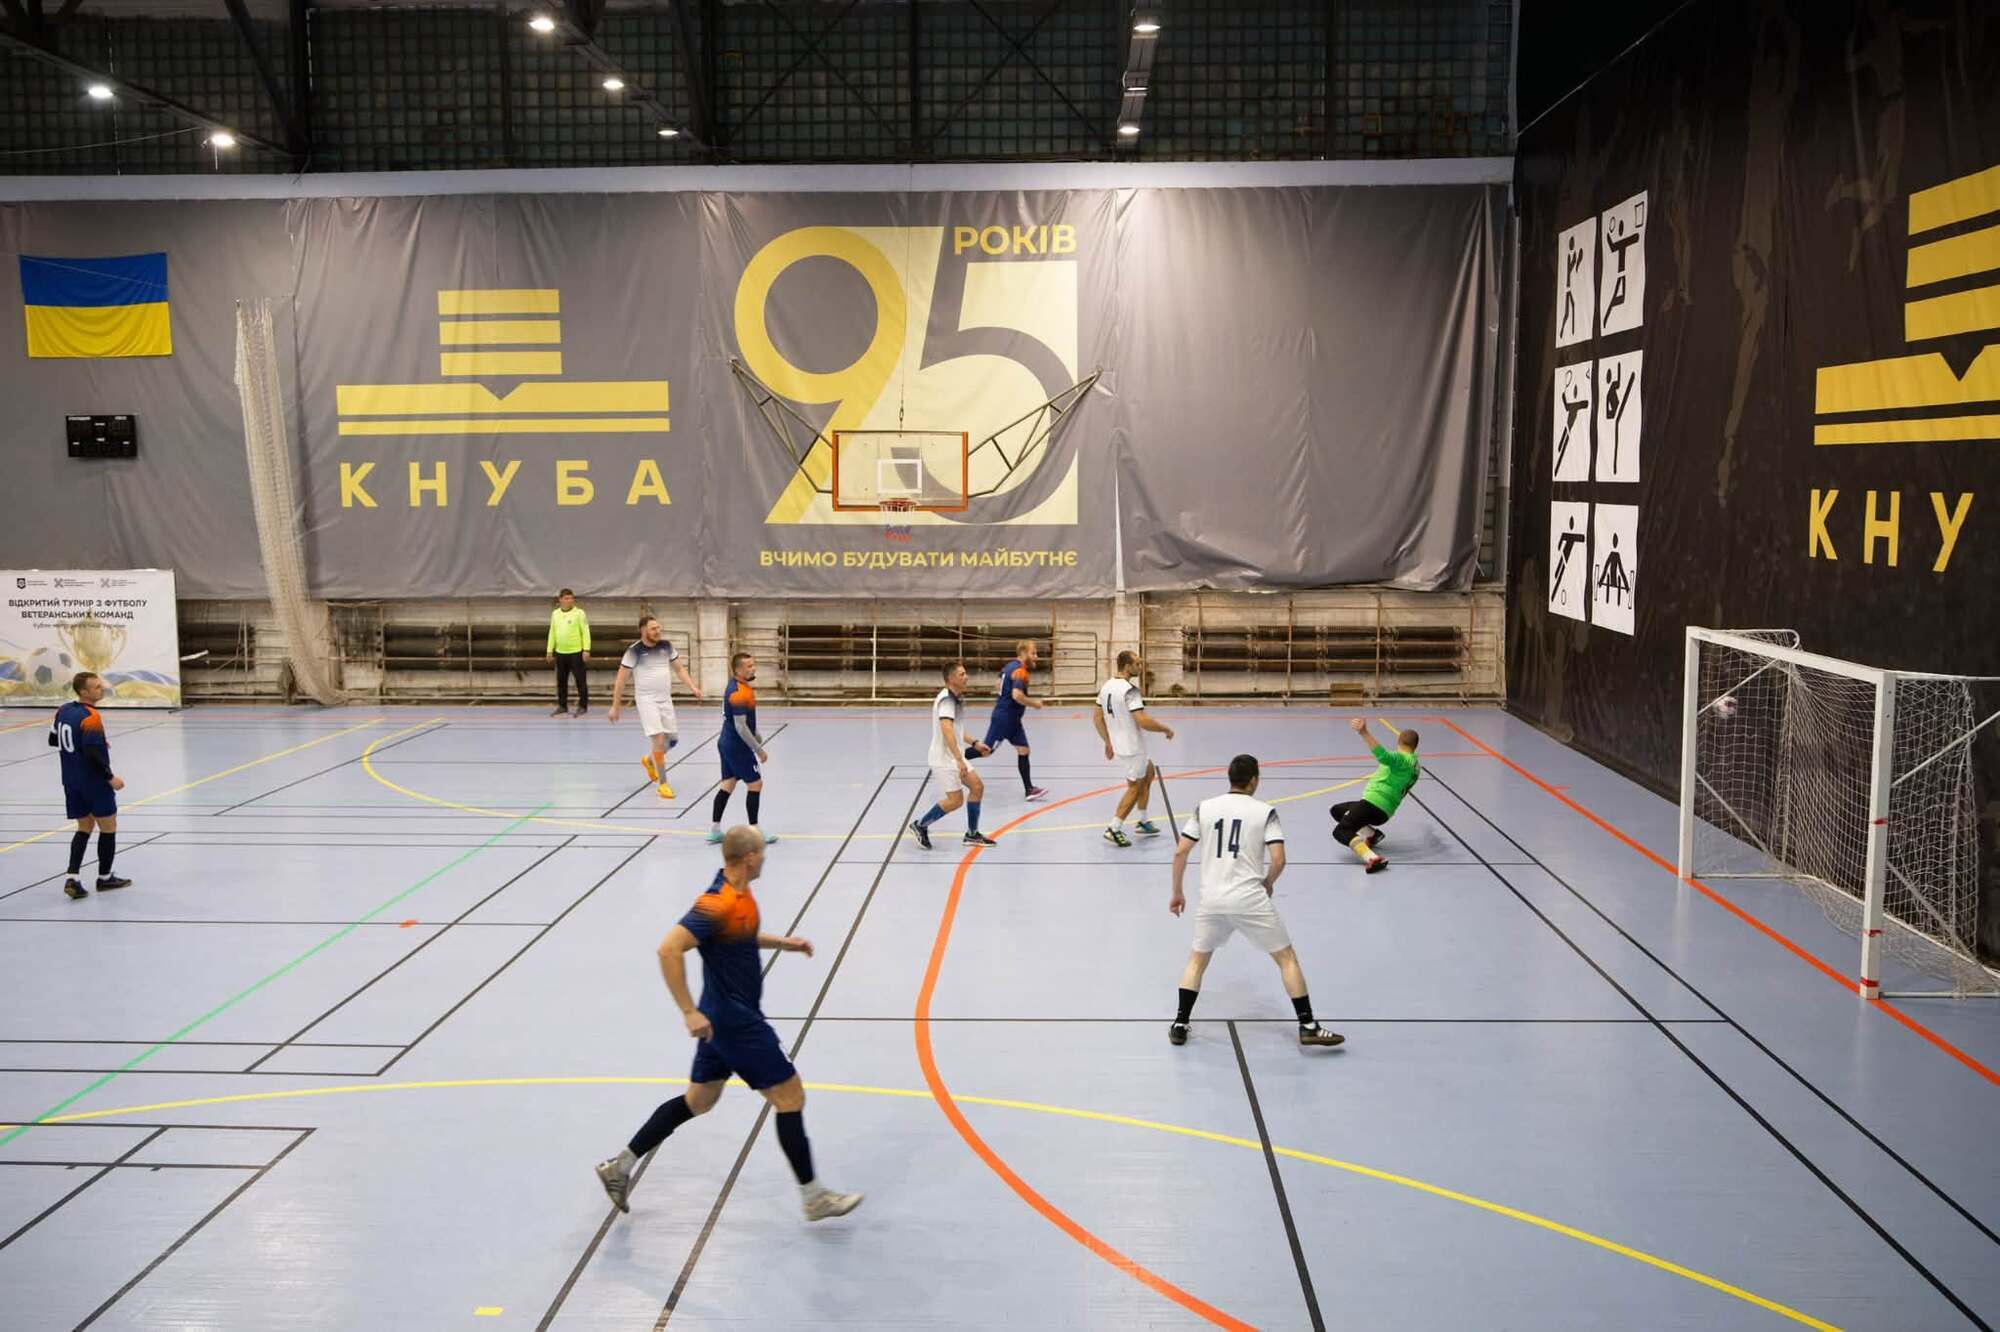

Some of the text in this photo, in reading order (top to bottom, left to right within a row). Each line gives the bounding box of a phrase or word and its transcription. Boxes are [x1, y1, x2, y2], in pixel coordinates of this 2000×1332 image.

[953, 224, 1078, 256] РОКІВ
[734, 225, 1079, 525] 95
[338, 458, 673, 508] КНУБА
[1808, 487, 1975, 573] КНУ
[759, 547, 1078, 570] ВЧИМО БУДУВАТИ МАЙБУТНЄ
[8, 597, 60, 608] ВІДКРИТИЙ
[62, 599, 94, 608] ТУРНІР
[104, 599, 148, 608] ФУТБОЛУ
[21, 610, 135, 620] ВЕТЕРАНСЬКИХ КОМАНД
[57, 721, 75, 753] 10
[1214, 817, 1243, 860] 14
